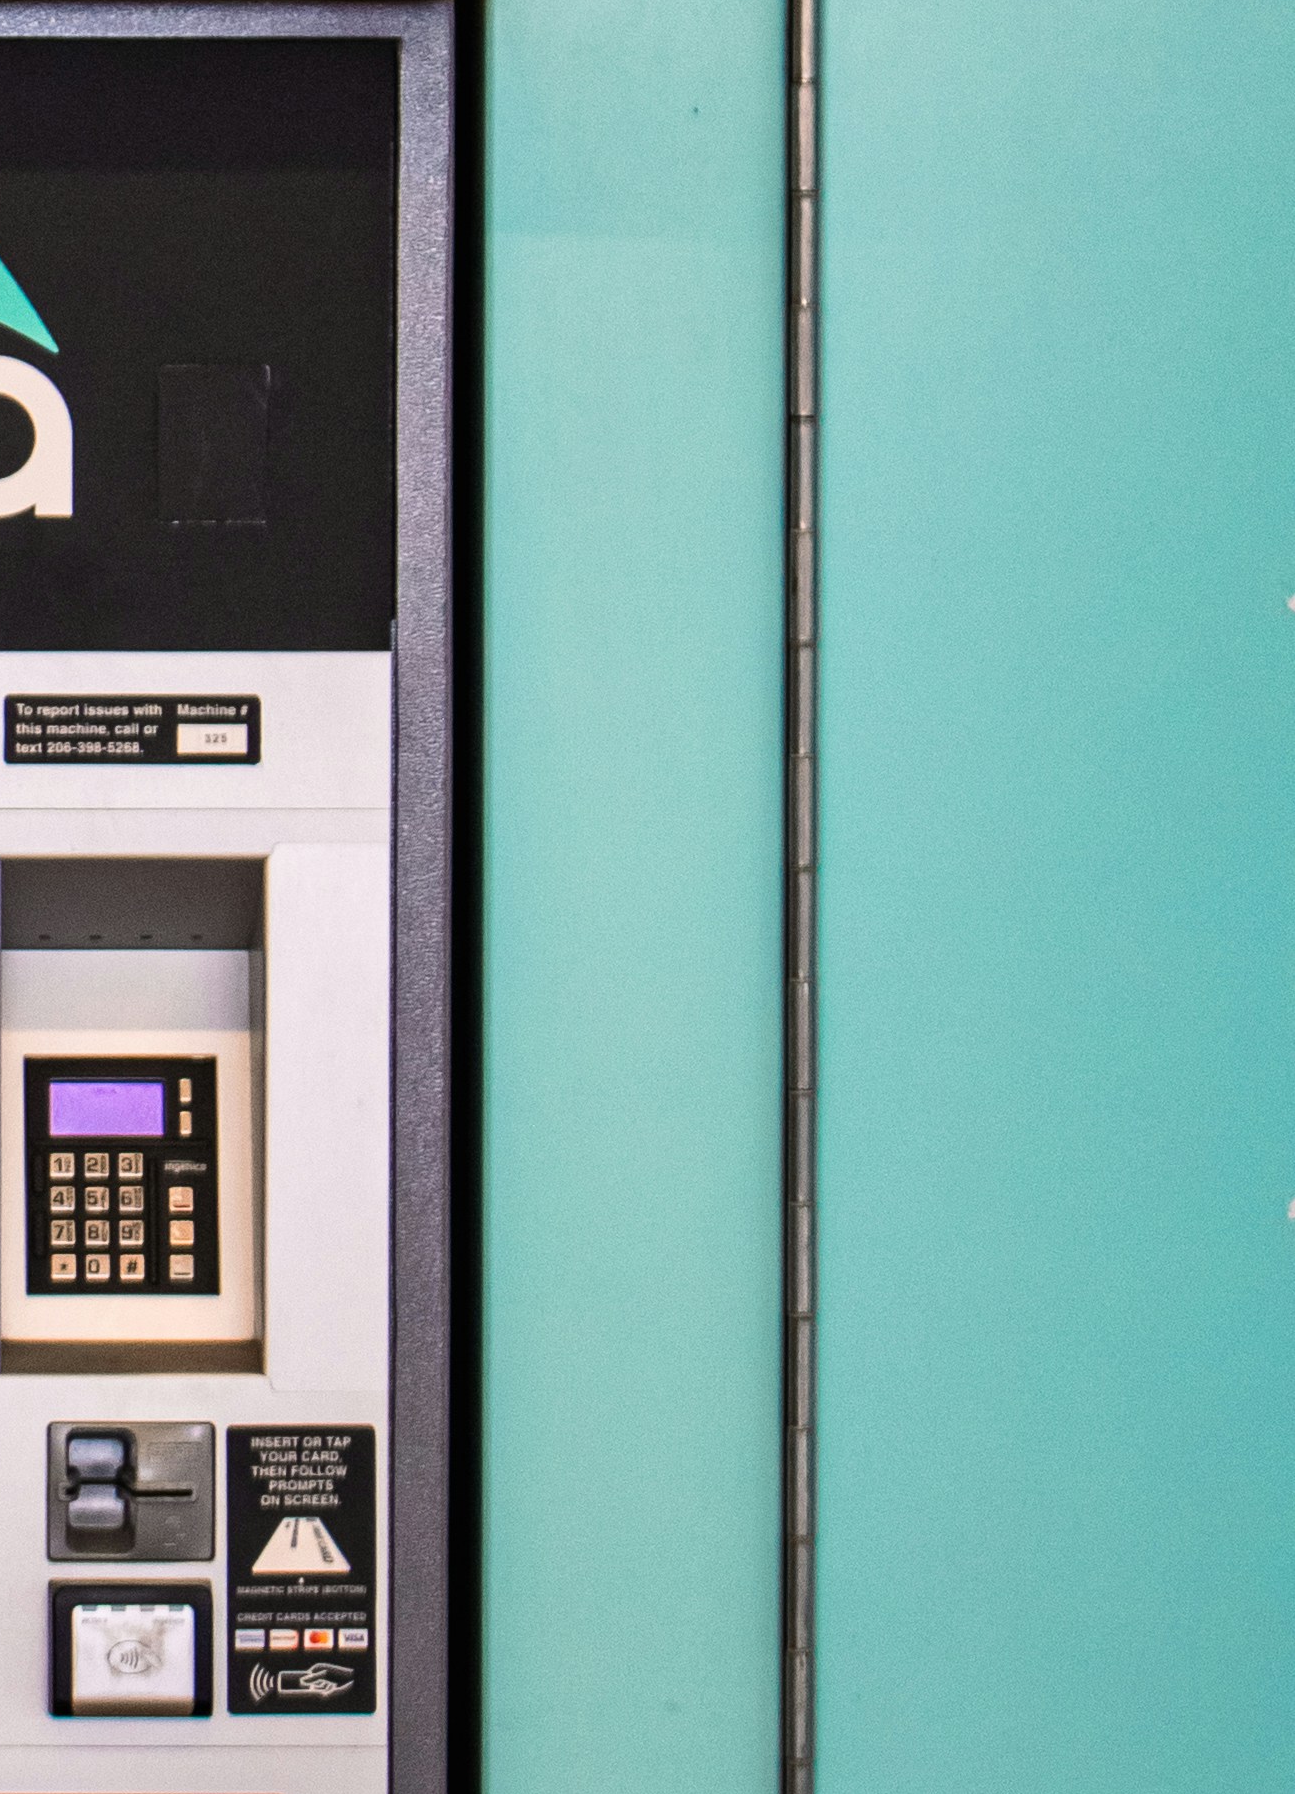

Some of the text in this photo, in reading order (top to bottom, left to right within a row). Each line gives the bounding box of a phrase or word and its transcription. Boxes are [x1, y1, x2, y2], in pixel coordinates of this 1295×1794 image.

[16, 702, 163, 719] To report issues with
[176, 703, 249, 717] Machine #
[15, 722, 159, 737] this machine, call or
[15, 742, 43, 754] text
[54, 1157, 64, 1171] 1
[87, 1157, 99, 1171] 2
[121, 1157, 132, 1171] 3
[53, 1191, 65, 1205] 4
[87, 1191, 98, 1205] 5
[121, 1191, 133, 1205] 6
[53, 1225, 65, 1239] 7
[88, 1226, 100, 1239] 8
[121, 1225, 133, 1239] 9
[251, 1436, 351, 1447] INSERT OR TAP
[259, 1451, 342, 1463] YOUR CARD,
[251, 1465, 347, 1476] THEN FOLLOW
[269, 1480, 334, 1491] PROMPTS
[260, 1494, 342, 1505] ON SCREEN.
[237, 1612, 367, 1622] CREDIT CARDS ACCEPTED
